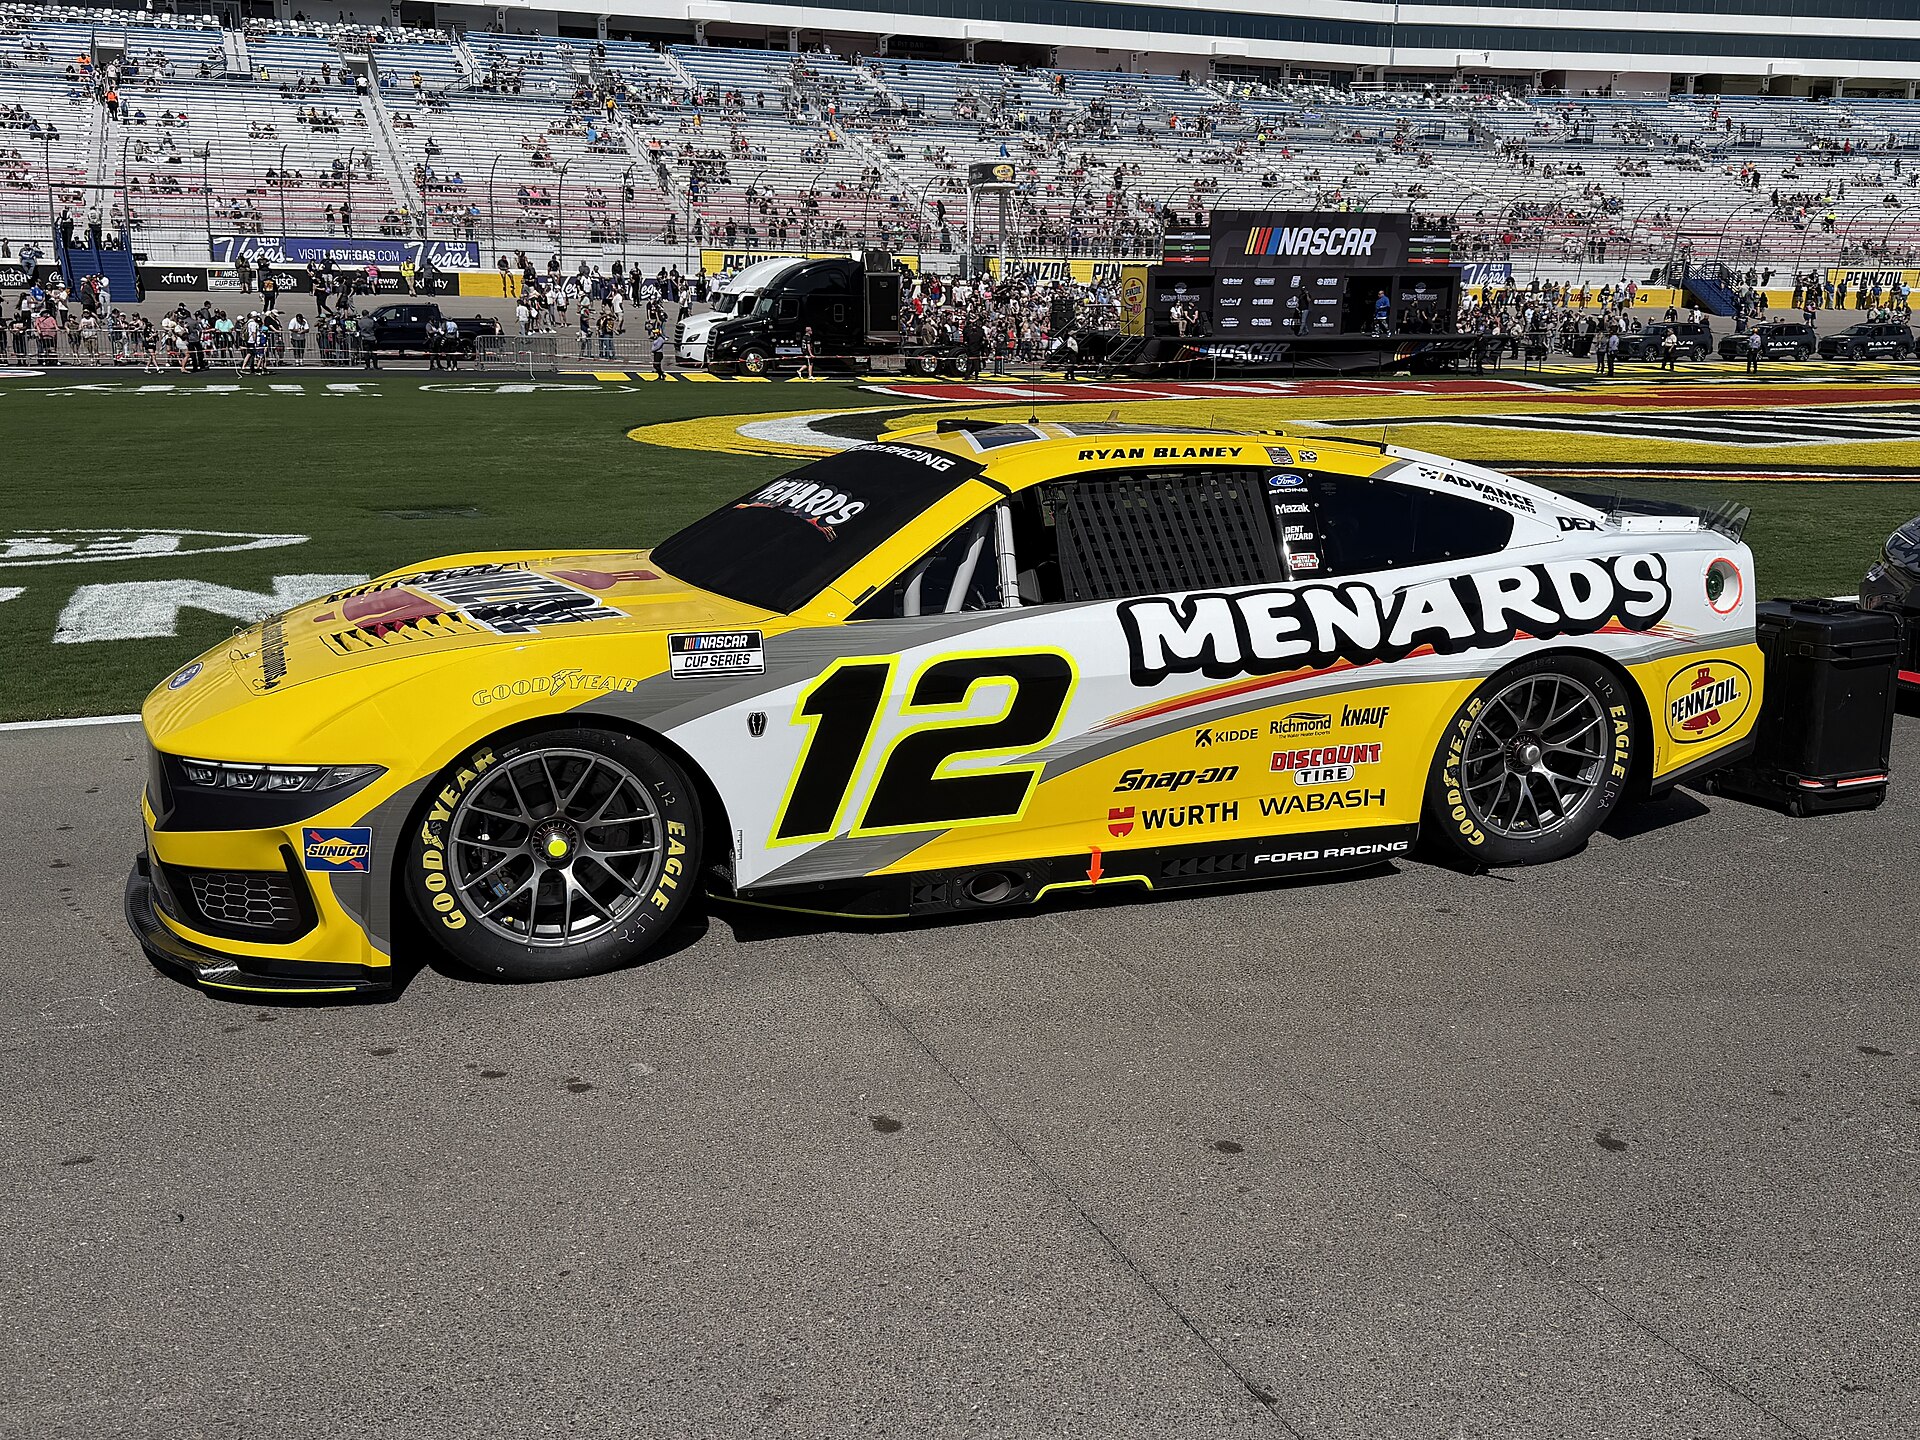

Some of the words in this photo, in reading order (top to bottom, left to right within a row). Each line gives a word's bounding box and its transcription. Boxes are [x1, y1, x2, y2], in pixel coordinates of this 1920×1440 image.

[1277, 227, 1377, 255] NASCAR
[404, 241, 479, 269] Vegas
[161, 272, 198, 285] xfinity
[274, 277, 297, 287] USCH
[1463, 264, 1506, 286] Vegas
[1845, 272, 1902, 286] PENNZOIL
[885, 446, 956, 472] RACING
[1078, 447, 1145, 461] RYAN
[1153, 446, 1243, 458] BLANEY
[1275, 475, 1298, 486] Ford
[1442, 474, 1535, 508] ADVANCE
[749, 479, 867, 525] MENARDS
[1275, 503, 1311, 515] Mazak
[1482, 493, 1507, 506] AUTO
[1508, 501, 1537, 514] PARTS
[1285, 525, 1304, 534] DENT
[1285, 533, 1313, 542] WIZARD
[1120, 553, 1670, 684] MENARDS
[699, 634, 748, 649] NASCAR
[684, 655, 708, 668] CUP
[710, 653, 751, 667] SERIES
[1671, 677, 1737, 727] PENNZOIL
[1215, 728, 1259, 743] KIDDE
[1270, 716, 1332, 735] Richmond
[764, 645, 1081, 849] 12
[1609, 704, 1630, 780] EAGLE
[1271, 743, 1382, 771] DISCOUNT
[1113, 765, 1240, 793] Snap-on
[1301, 768, 1348, 783] TIRE
[1259, 788, 1386, 817] WABASH
[1142, 801, 1239, 830] WÜRTH
[308, 845, 367, 857] SUNOCO
[1253, 851, 1319, 865] FORD
[1322, 841, 1409, 858] RACING
[650, 820, 686, 912] EAGLE
